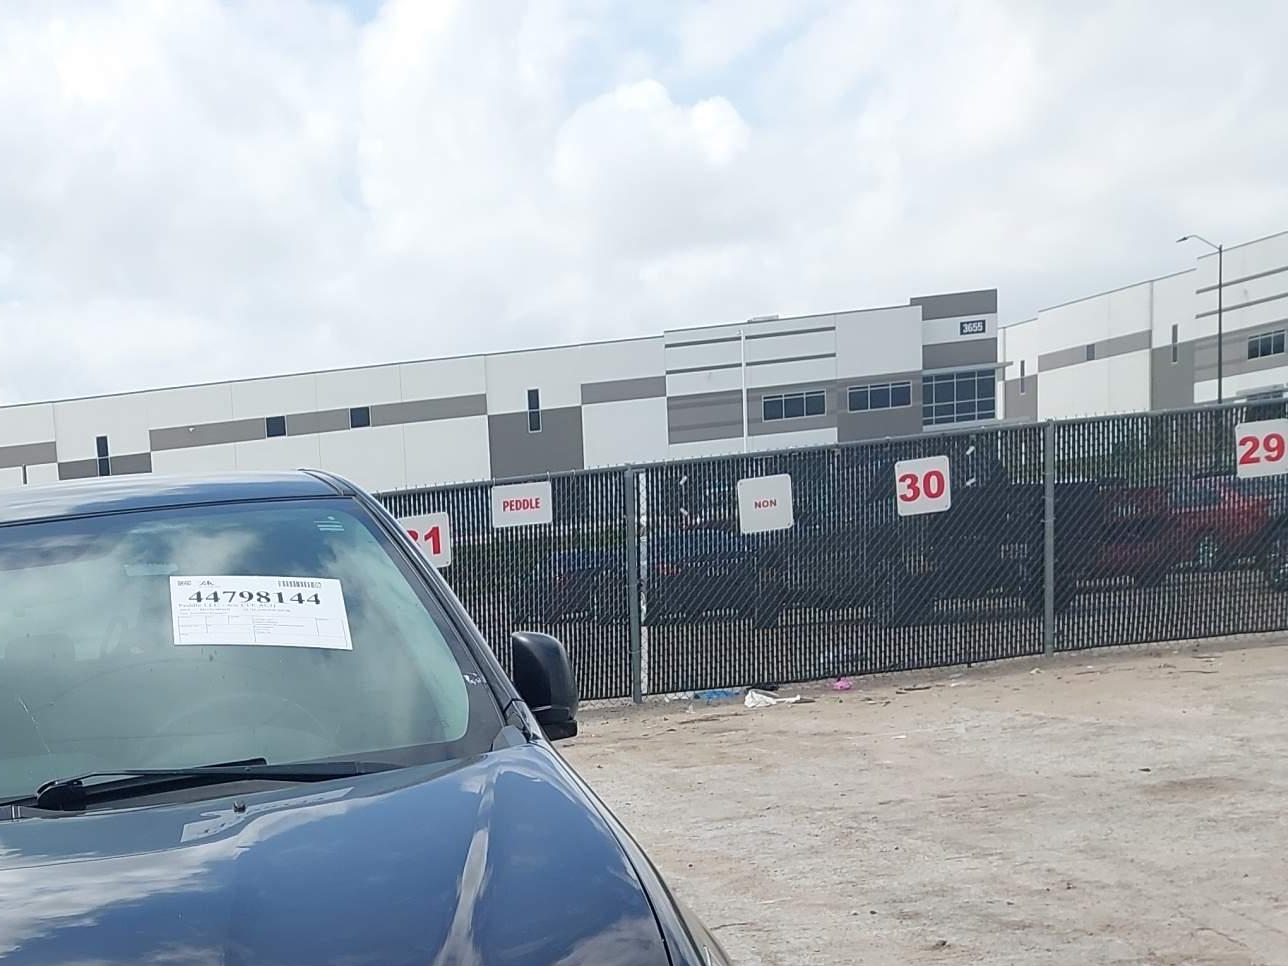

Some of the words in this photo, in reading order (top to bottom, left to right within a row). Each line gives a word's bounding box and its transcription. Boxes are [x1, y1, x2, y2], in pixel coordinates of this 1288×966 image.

[962, 321, 983, 333] 3655
[1239, 433, 1285, 465] 29
[899, 470, 945, 502] 30
[503, 497, 540, 512] PEDDLE
[754, 499, 777, 509] NON
[188, 590, 321, 605] 44798144
